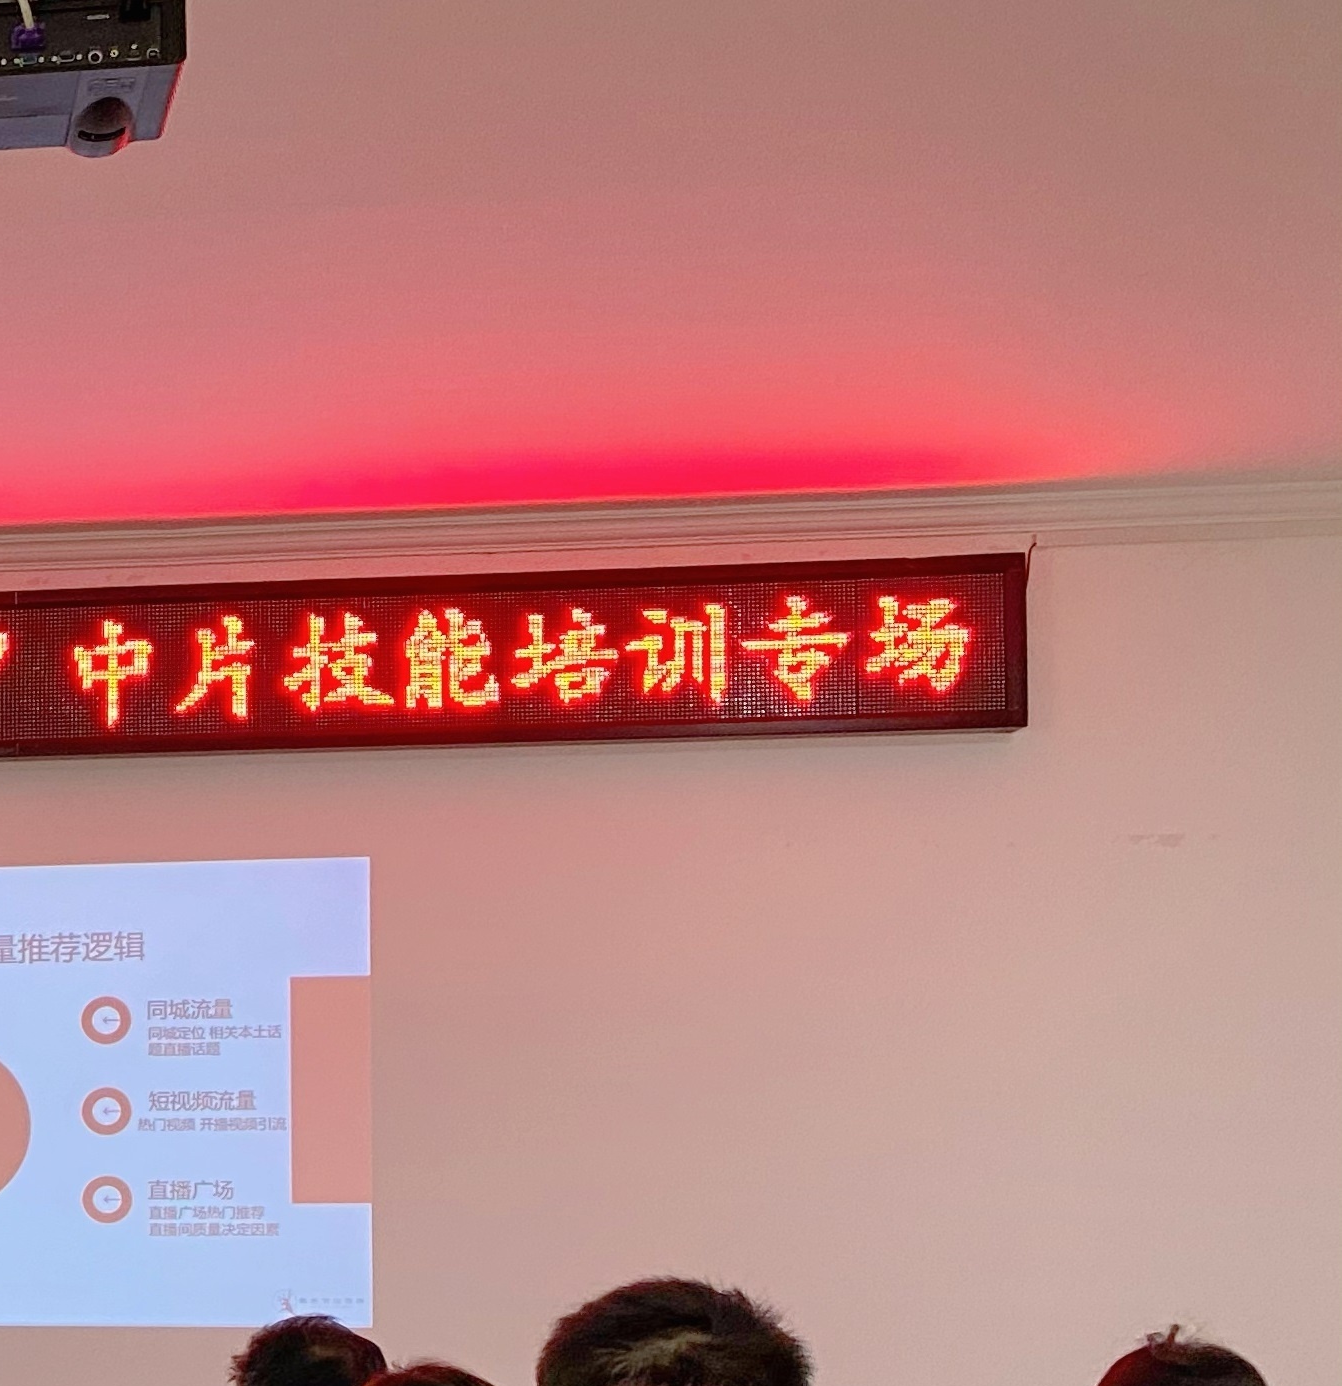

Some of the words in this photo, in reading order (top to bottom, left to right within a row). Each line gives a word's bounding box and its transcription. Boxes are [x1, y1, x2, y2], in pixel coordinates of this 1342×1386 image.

[72, 594, 971, 728] 中片技能培训专场
[147, 999, 233, 1020] 同城流量
[148, 1090, 257, 1111] 短视频流量
[148, 1180, 234, 1200] 直播广场
